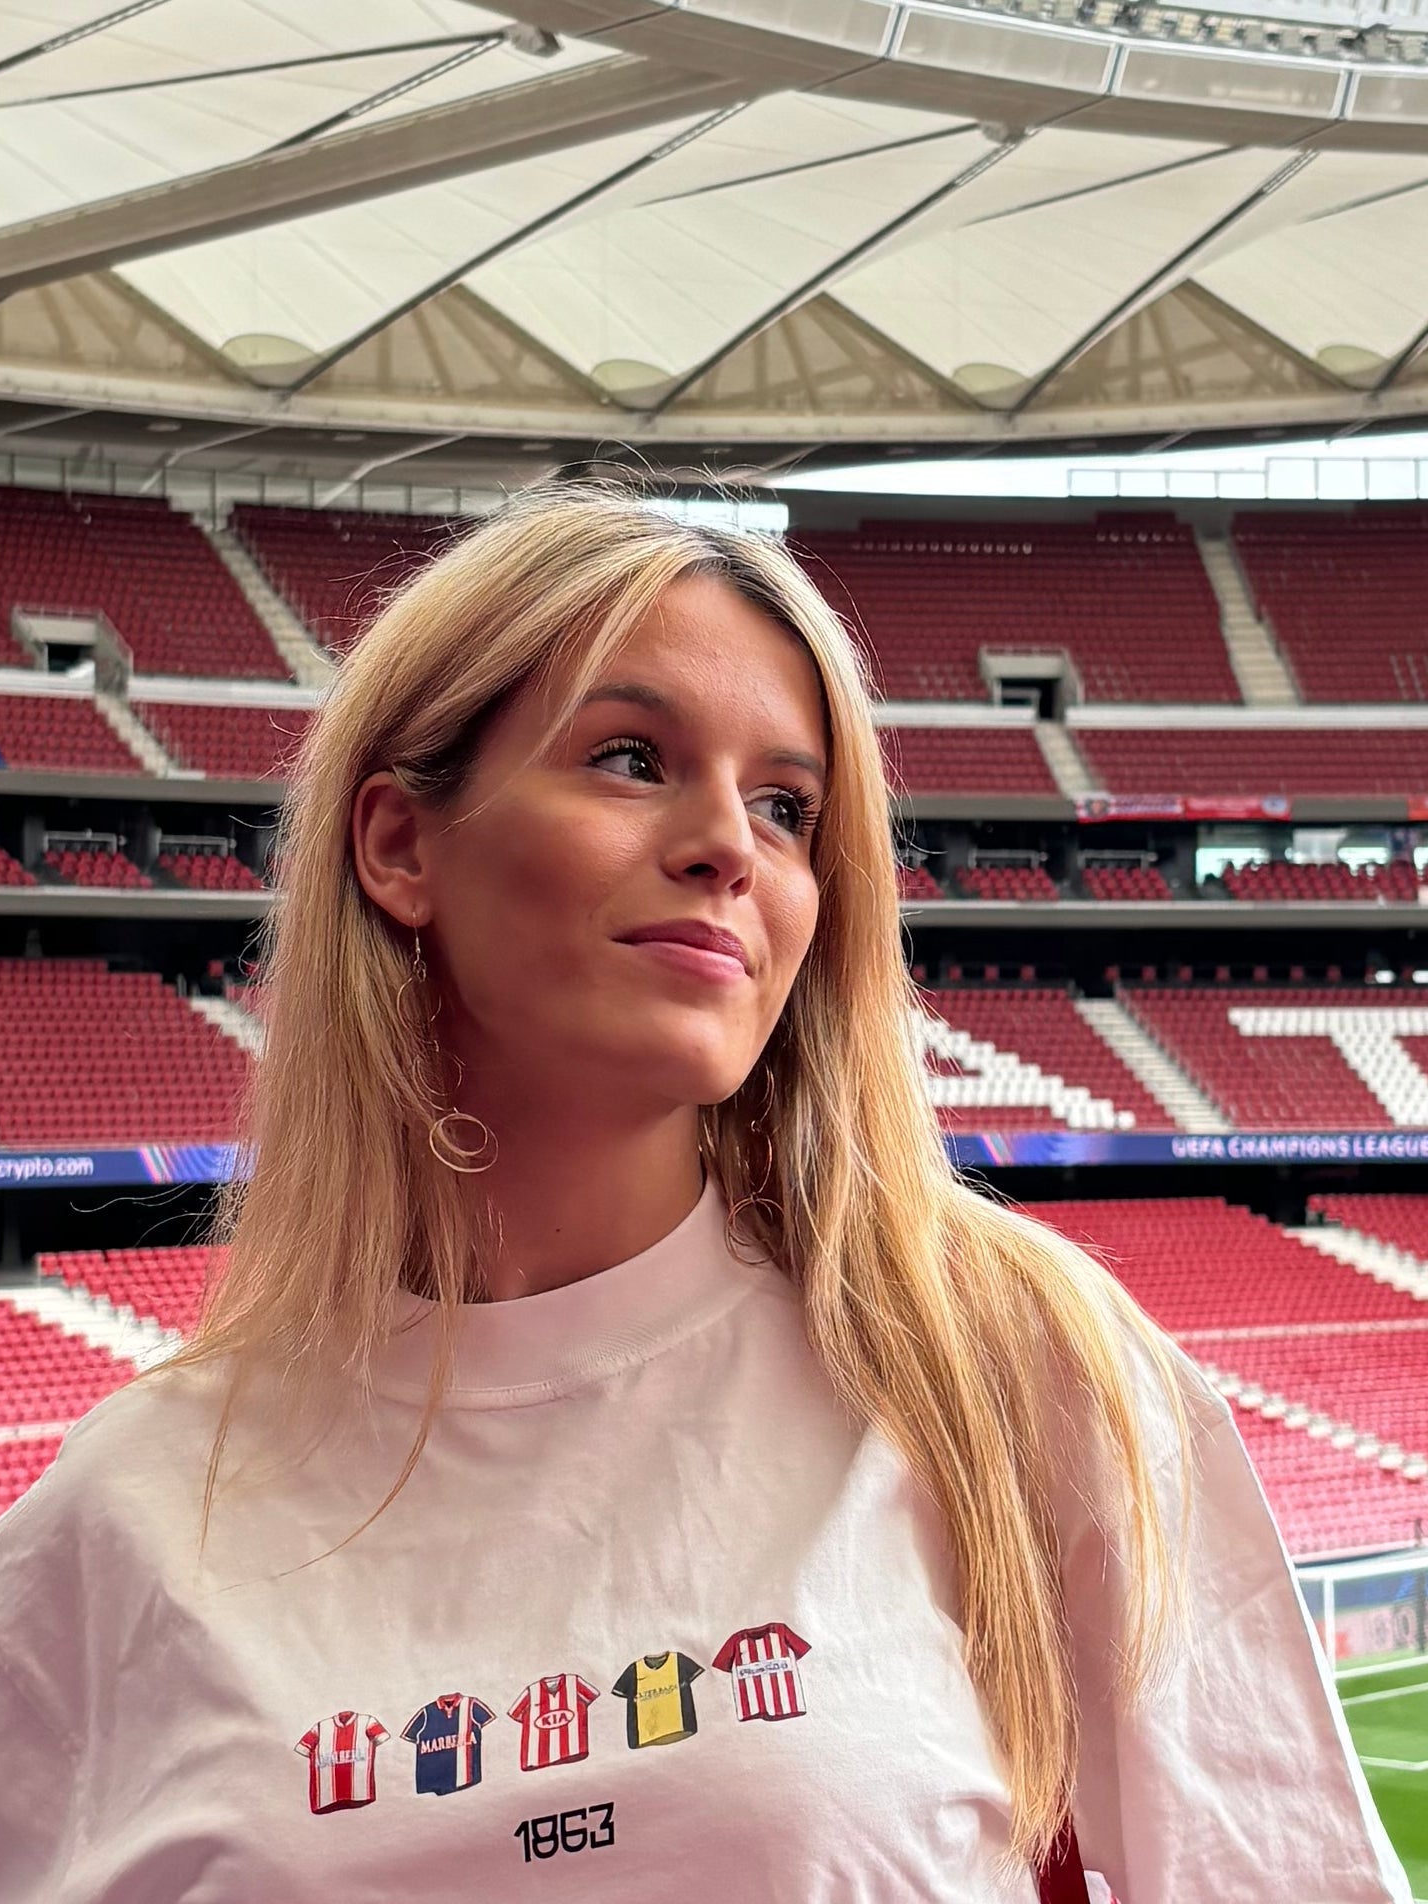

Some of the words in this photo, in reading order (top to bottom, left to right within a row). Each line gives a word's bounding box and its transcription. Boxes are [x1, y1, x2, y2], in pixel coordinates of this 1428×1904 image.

[1172, 1135, 1224, 1159] UEFA
[1227, 1135, 1350, 1159] CHAMPIONS
[541, 1711, 570, 1727] KIA
[514, 1801, 615, 1863] 1863
